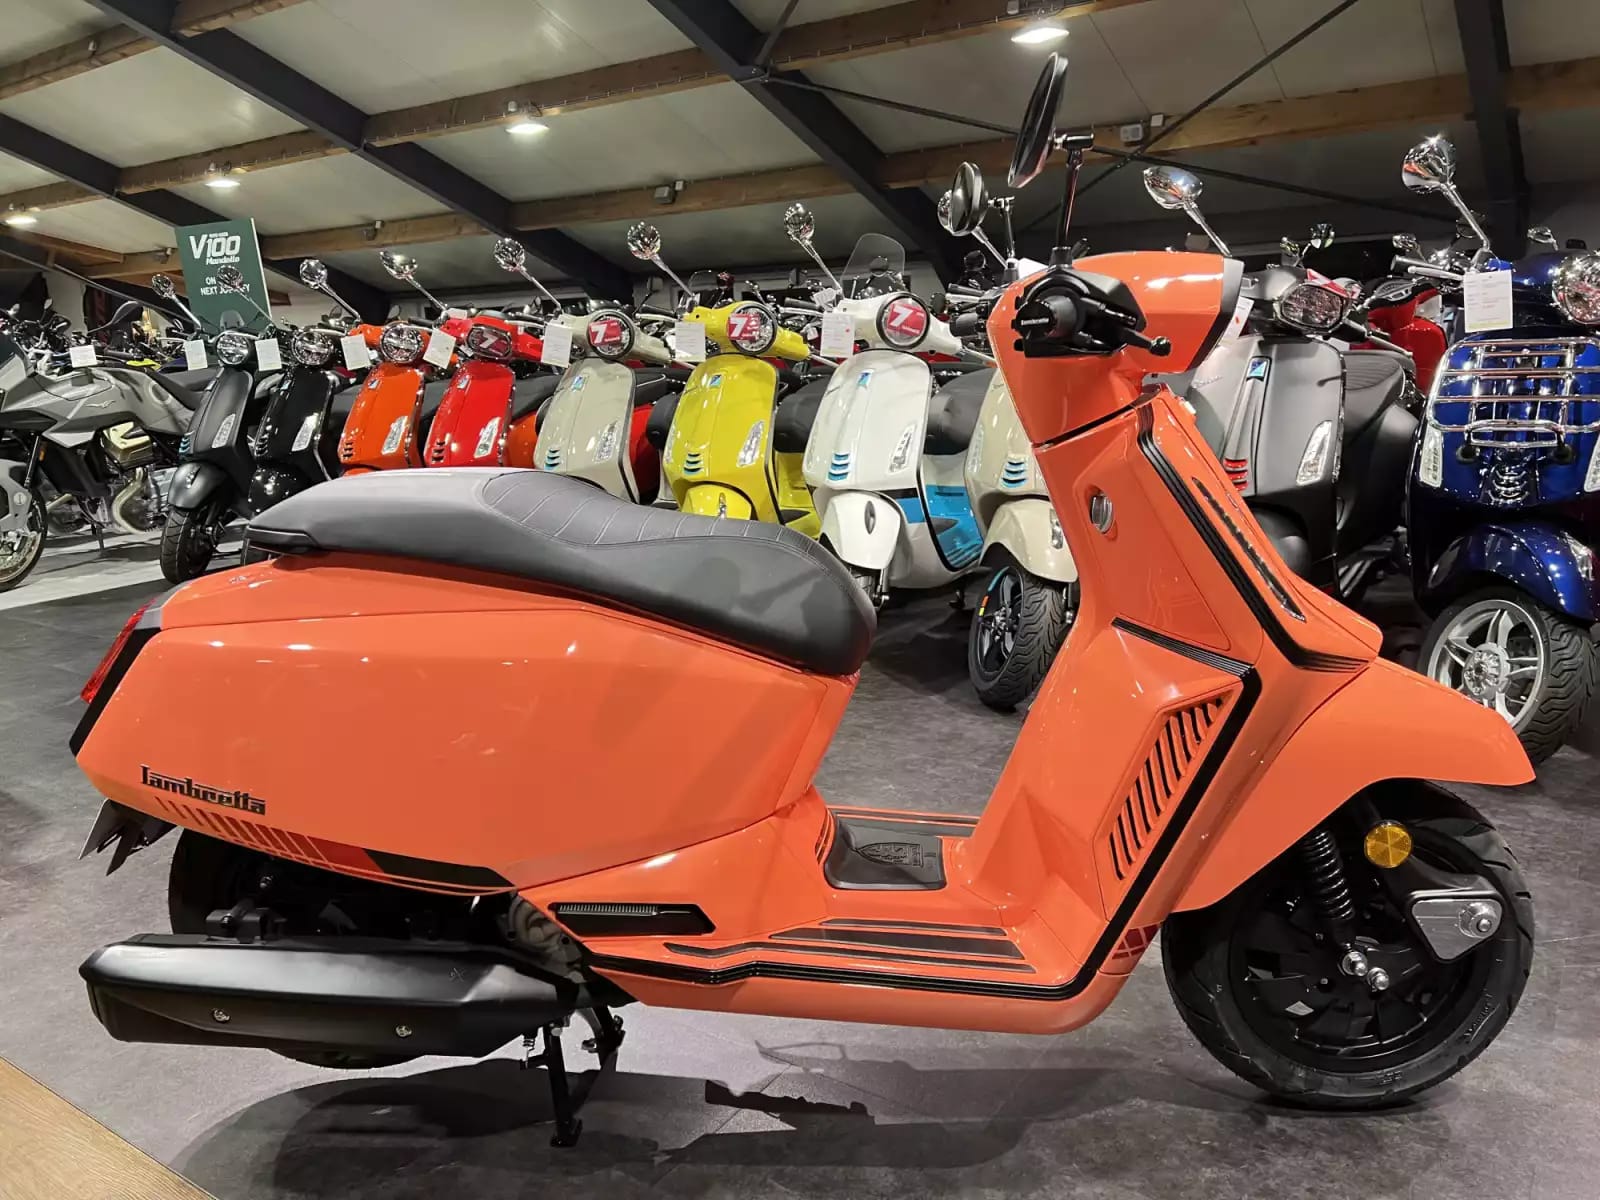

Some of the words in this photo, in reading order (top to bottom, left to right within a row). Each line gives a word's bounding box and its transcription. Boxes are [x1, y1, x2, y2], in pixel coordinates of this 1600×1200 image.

[189, 234, 241, 259] V100
[200, 286, 218, 296] NEXT
[205, 276, 217, 285] ON
[890, 303, 914, 328] 7
[590, 323, 608, 345] 7
[729, 316, 749, 338] 7
